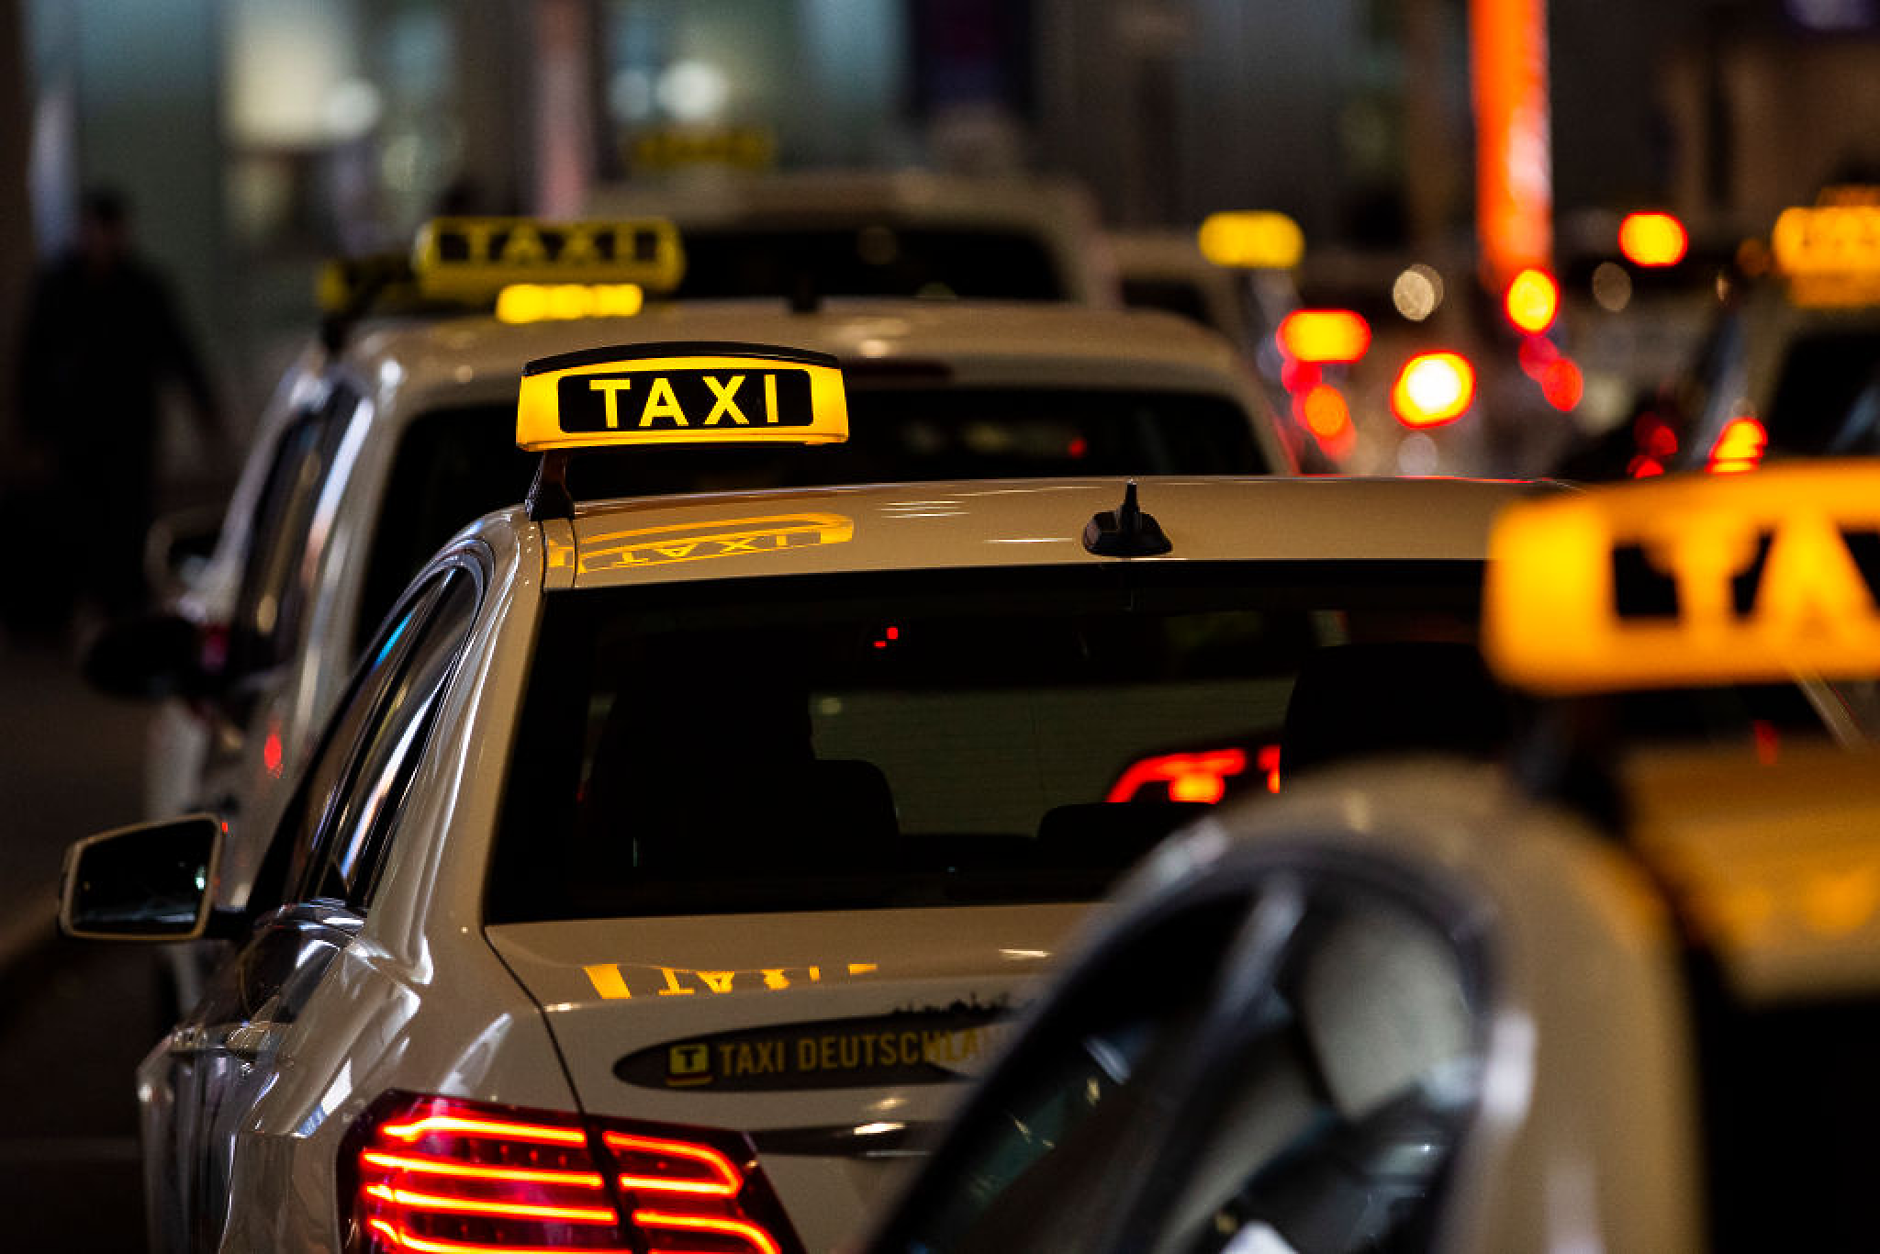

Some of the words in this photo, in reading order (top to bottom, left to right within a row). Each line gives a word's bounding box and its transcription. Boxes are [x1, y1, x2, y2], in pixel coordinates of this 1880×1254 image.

[456, 228, 635, 264] TAXI
[589, 374, 779, 428] TAXI
[679, 1049, 702, 1068] T
[719, 1039, 786, 1076] TAXI
[799, 1028, 988, 1070] DEUTSCHLA
